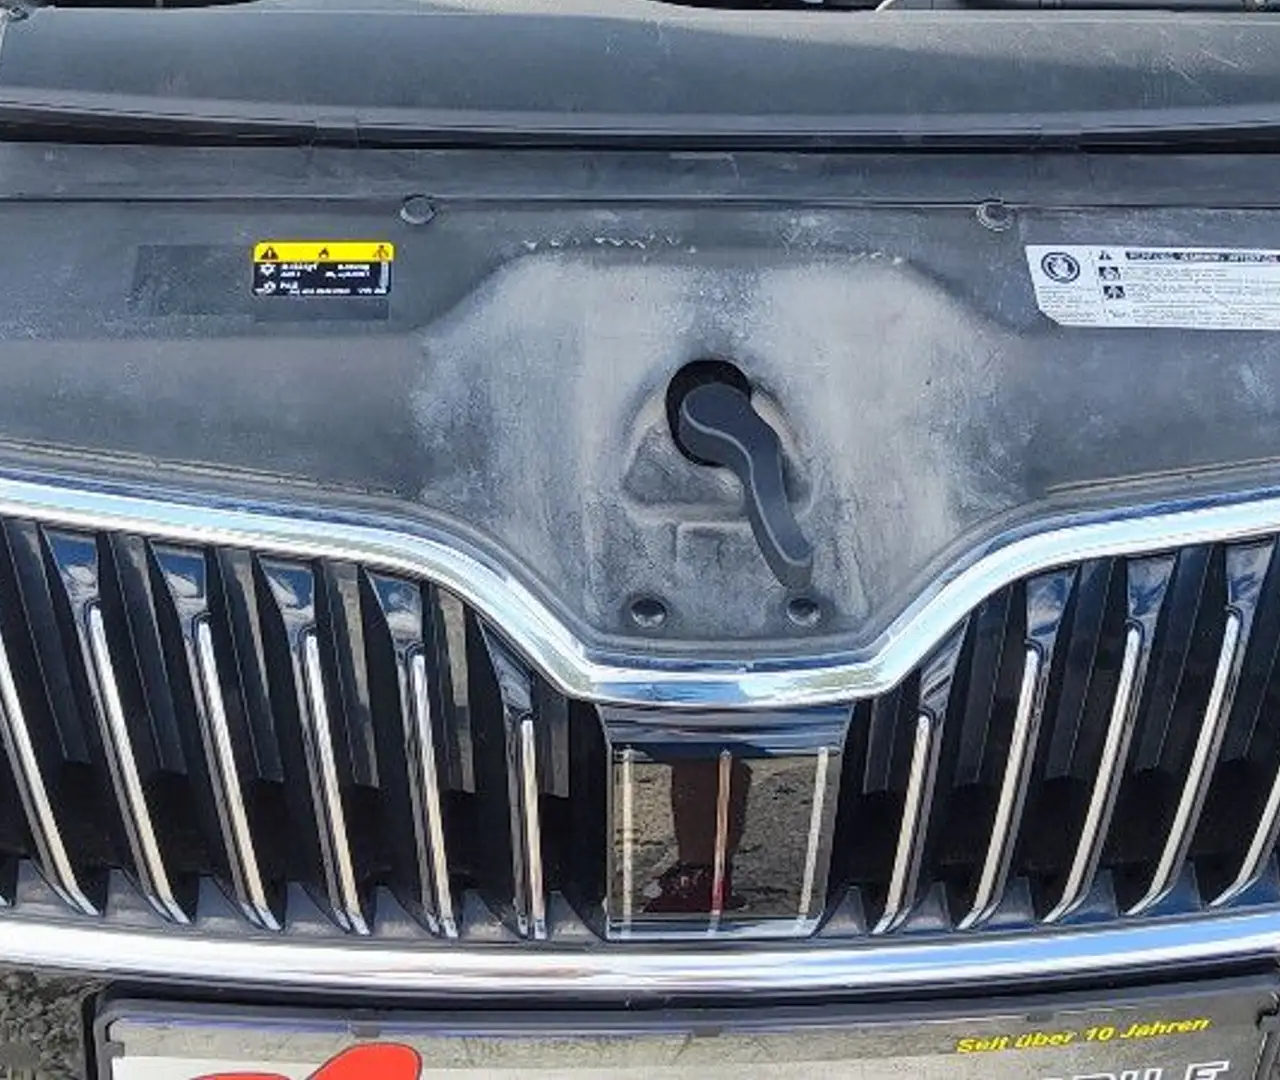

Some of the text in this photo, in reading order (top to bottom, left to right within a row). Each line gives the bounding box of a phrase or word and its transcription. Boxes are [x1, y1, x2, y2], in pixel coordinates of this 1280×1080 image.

[956, 1034, 1009, 1053] Seit
[1085, 1025, 1115, 1042] 10
[1120, 1018, 1211, 1039] Jahren
